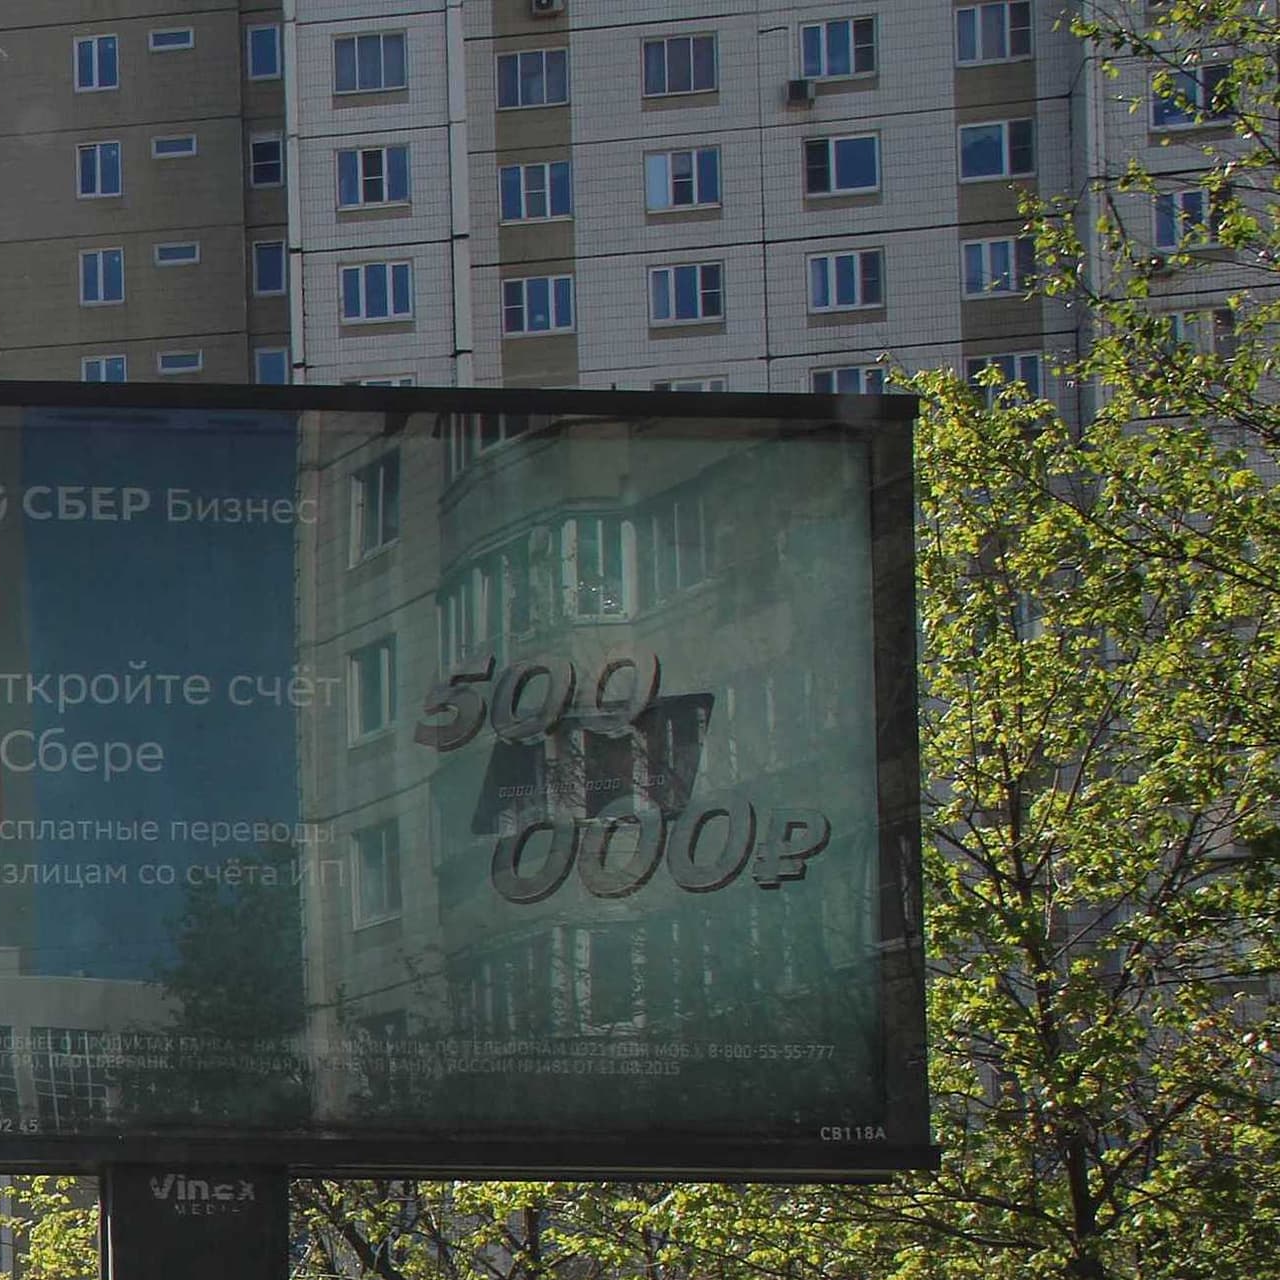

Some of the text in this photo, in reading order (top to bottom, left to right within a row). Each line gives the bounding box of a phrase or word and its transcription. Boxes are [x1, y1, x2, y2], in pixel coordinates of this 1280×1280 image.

[23, 486, 319, 524] СБЕР Бизнес
[228, 666, 342, 707] счёт
[413, 652, 662, 753] 500
[0, 728, 165, 782] Сбере
[170, 822, 336, 846] переводы
[140, 864, 175, 886] со
[186, 857, 278, 887] счёта
[291, 860, 345, 888] ИП
[709, 1044, 835, 1059] 8-800-55-55-777
